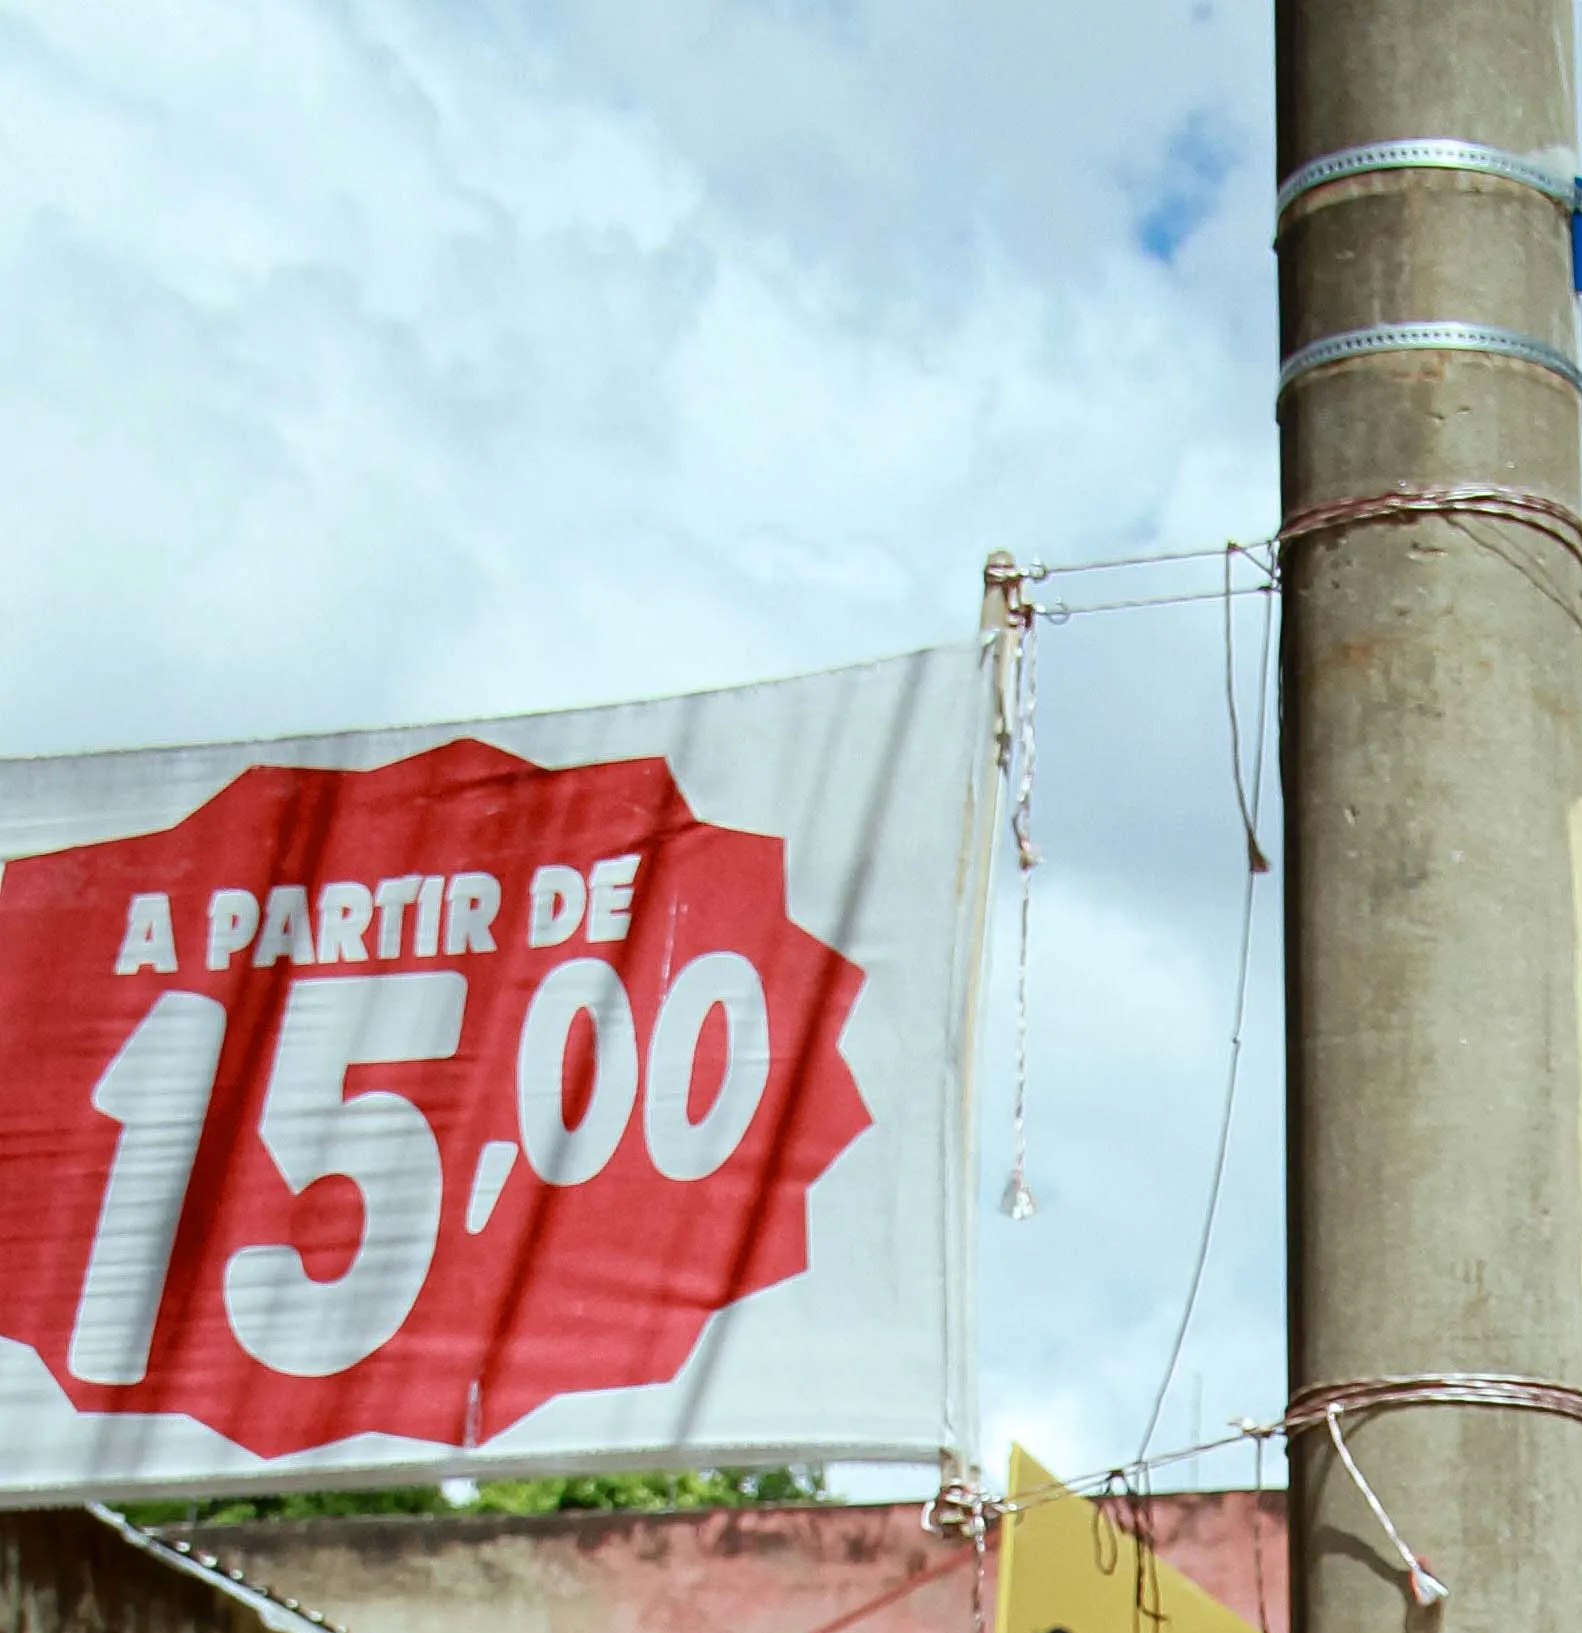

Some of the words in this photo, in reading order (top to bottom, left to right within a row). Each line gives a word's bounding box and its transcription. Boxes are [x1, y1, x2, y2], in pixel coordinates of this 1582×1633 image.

[115, 892, 179, 975] A
[206, 872, 502, 972] PARTIR
[528, 853, 643, 949] DE
[68, 950, 771, 1386] 15,00
